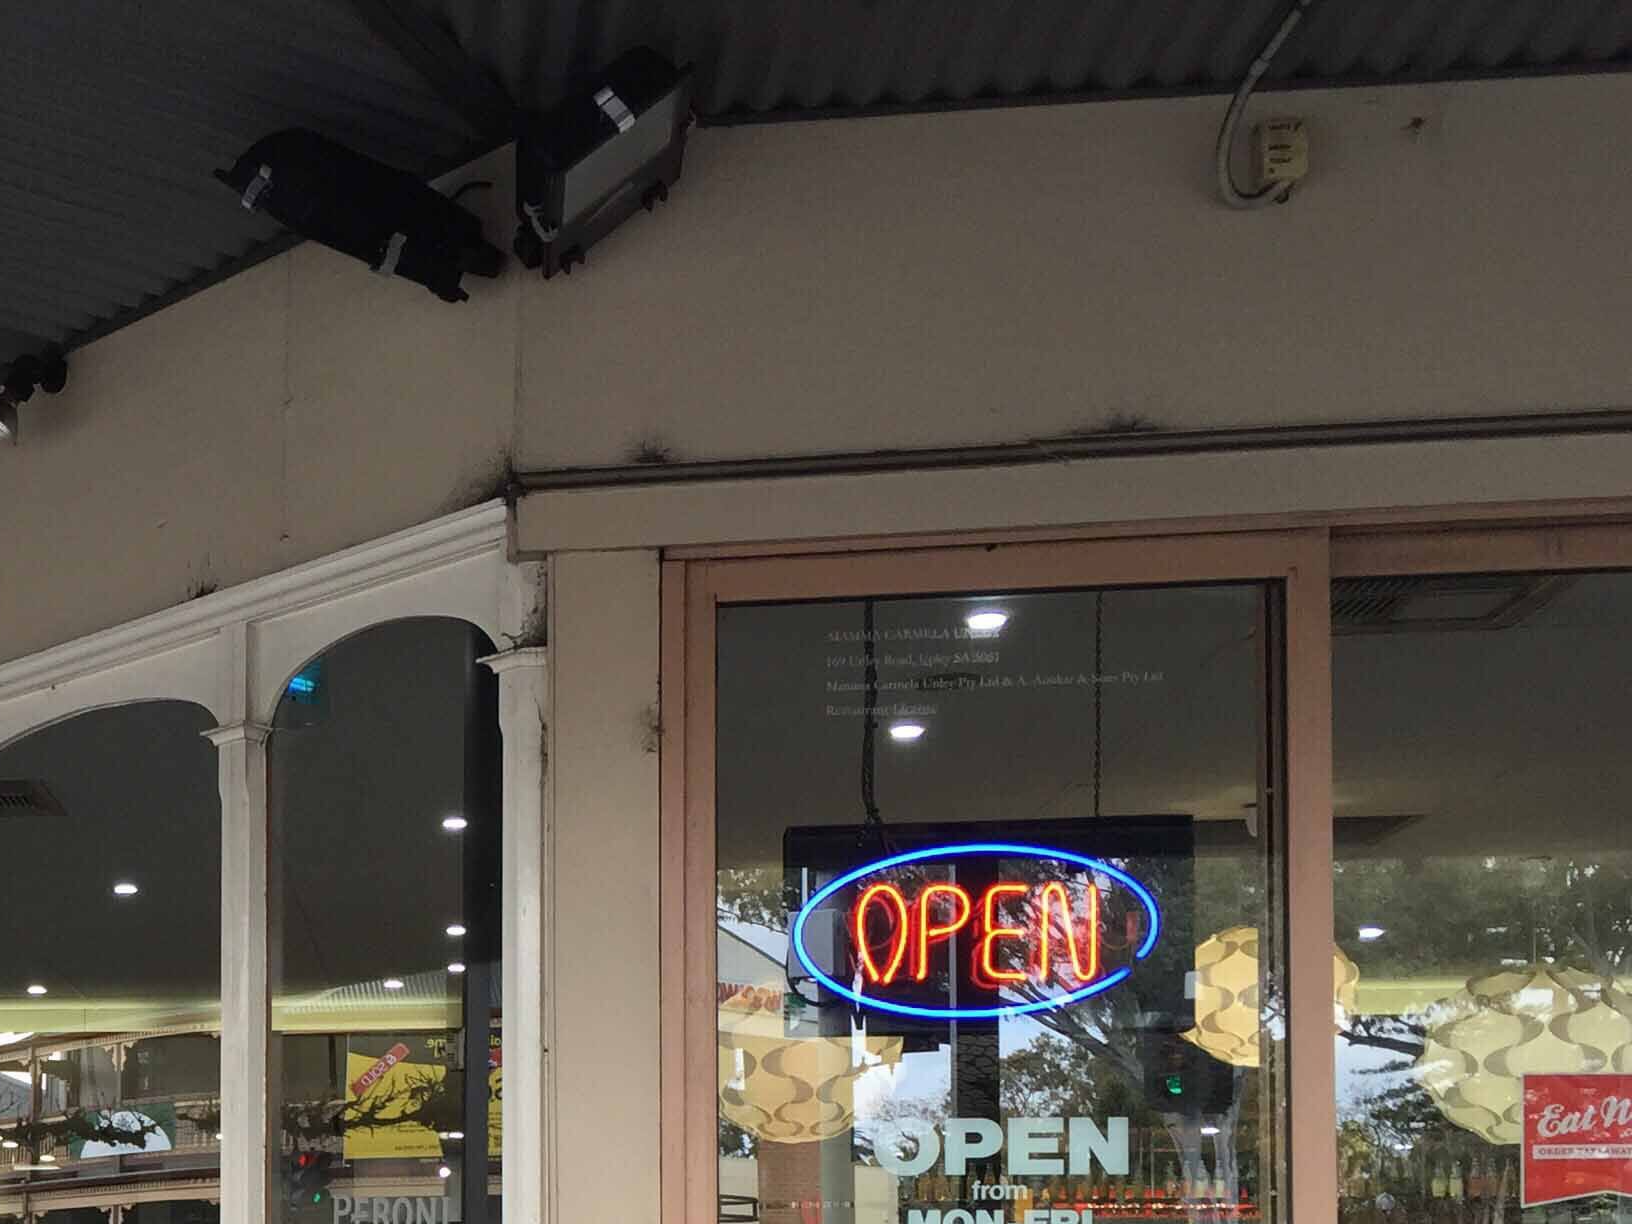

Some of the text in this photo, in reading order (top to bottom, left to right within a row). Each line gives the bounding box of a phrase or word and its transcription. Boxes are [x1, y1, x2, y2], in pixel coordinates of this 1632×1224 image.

[952, 651, 970, 665] SA
[957, 675, 976, 692] Pty
[854, 881, 1100, 986] OPEN
[1536, 1103, 1598, 1139] Eat
[873, 1116, 1129, 1177] OPEN
[971, 1180, 1029, 1201] from
